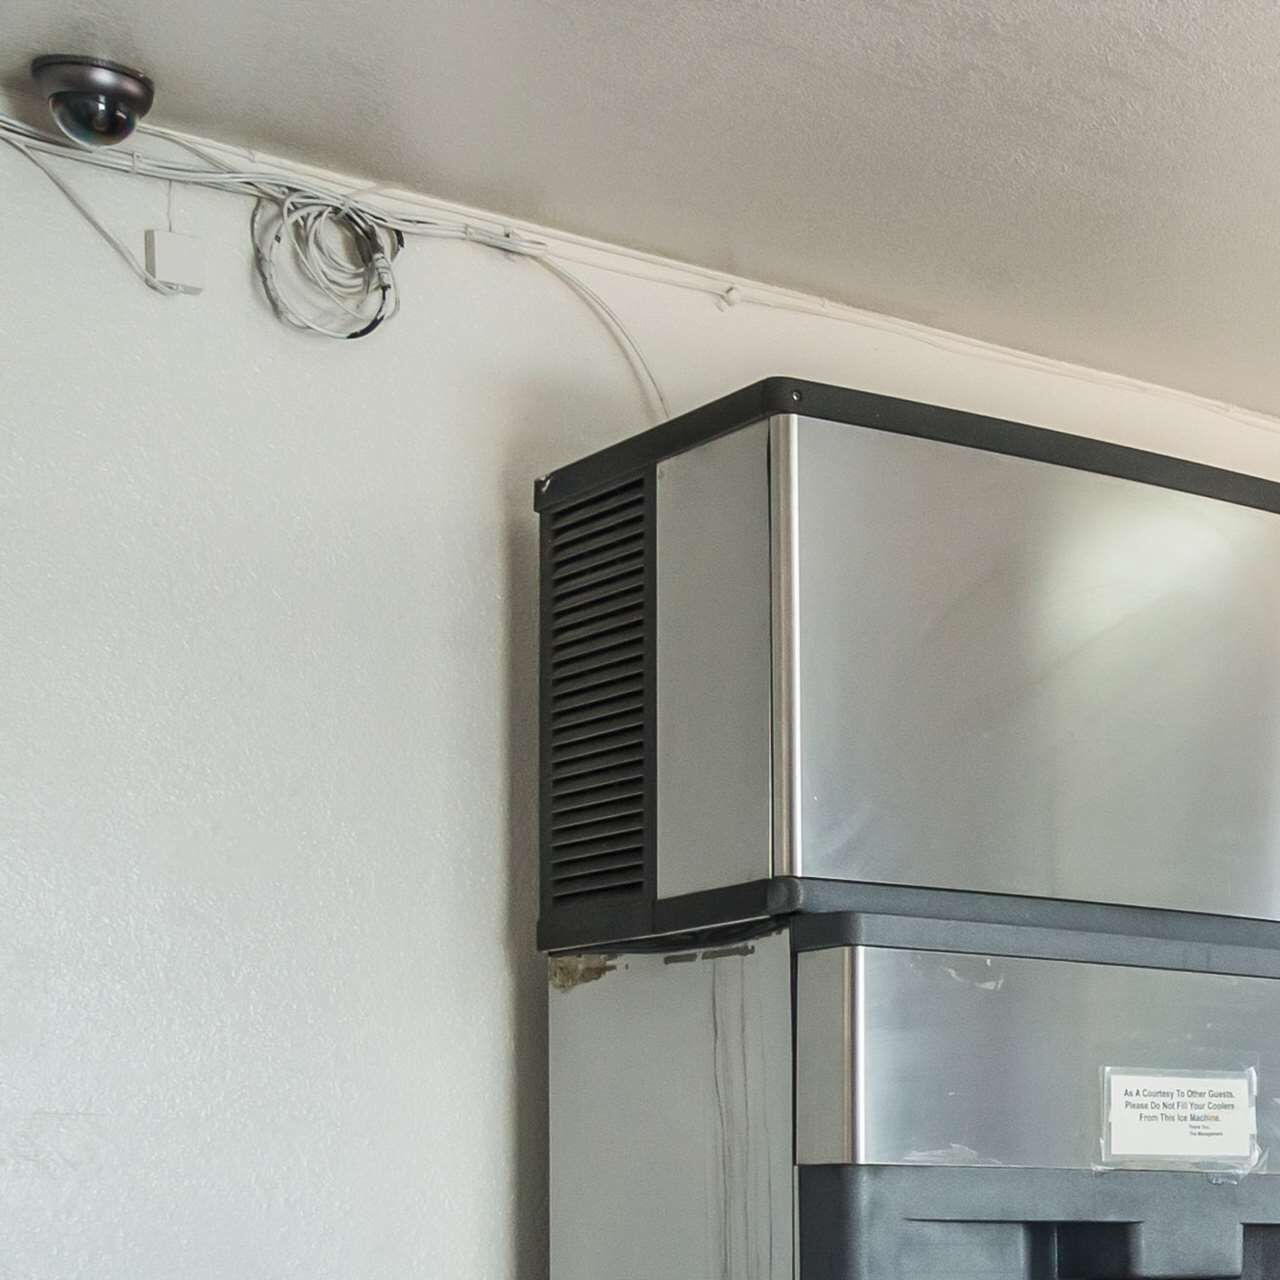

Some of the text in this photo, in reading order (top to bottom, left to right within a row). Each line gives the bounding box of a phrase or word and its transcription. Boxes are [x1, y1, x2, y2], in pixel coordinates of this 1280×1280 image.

[1124, 1089, 1134, 1098] As
[1142, 1089, 1174, 1099] Courtesy
[1176, 1089, 1185, 1098] To
[1187, 1089, 1206, 1098] Other
[1125, 1101, 1235, 1110] Please Do Not Fill Your Coolers
[1139, 1113, 1158, 1122] From
[1160, 1113, 1175, 1122] This
[1177, 1114, 1188, 1122] Ice
